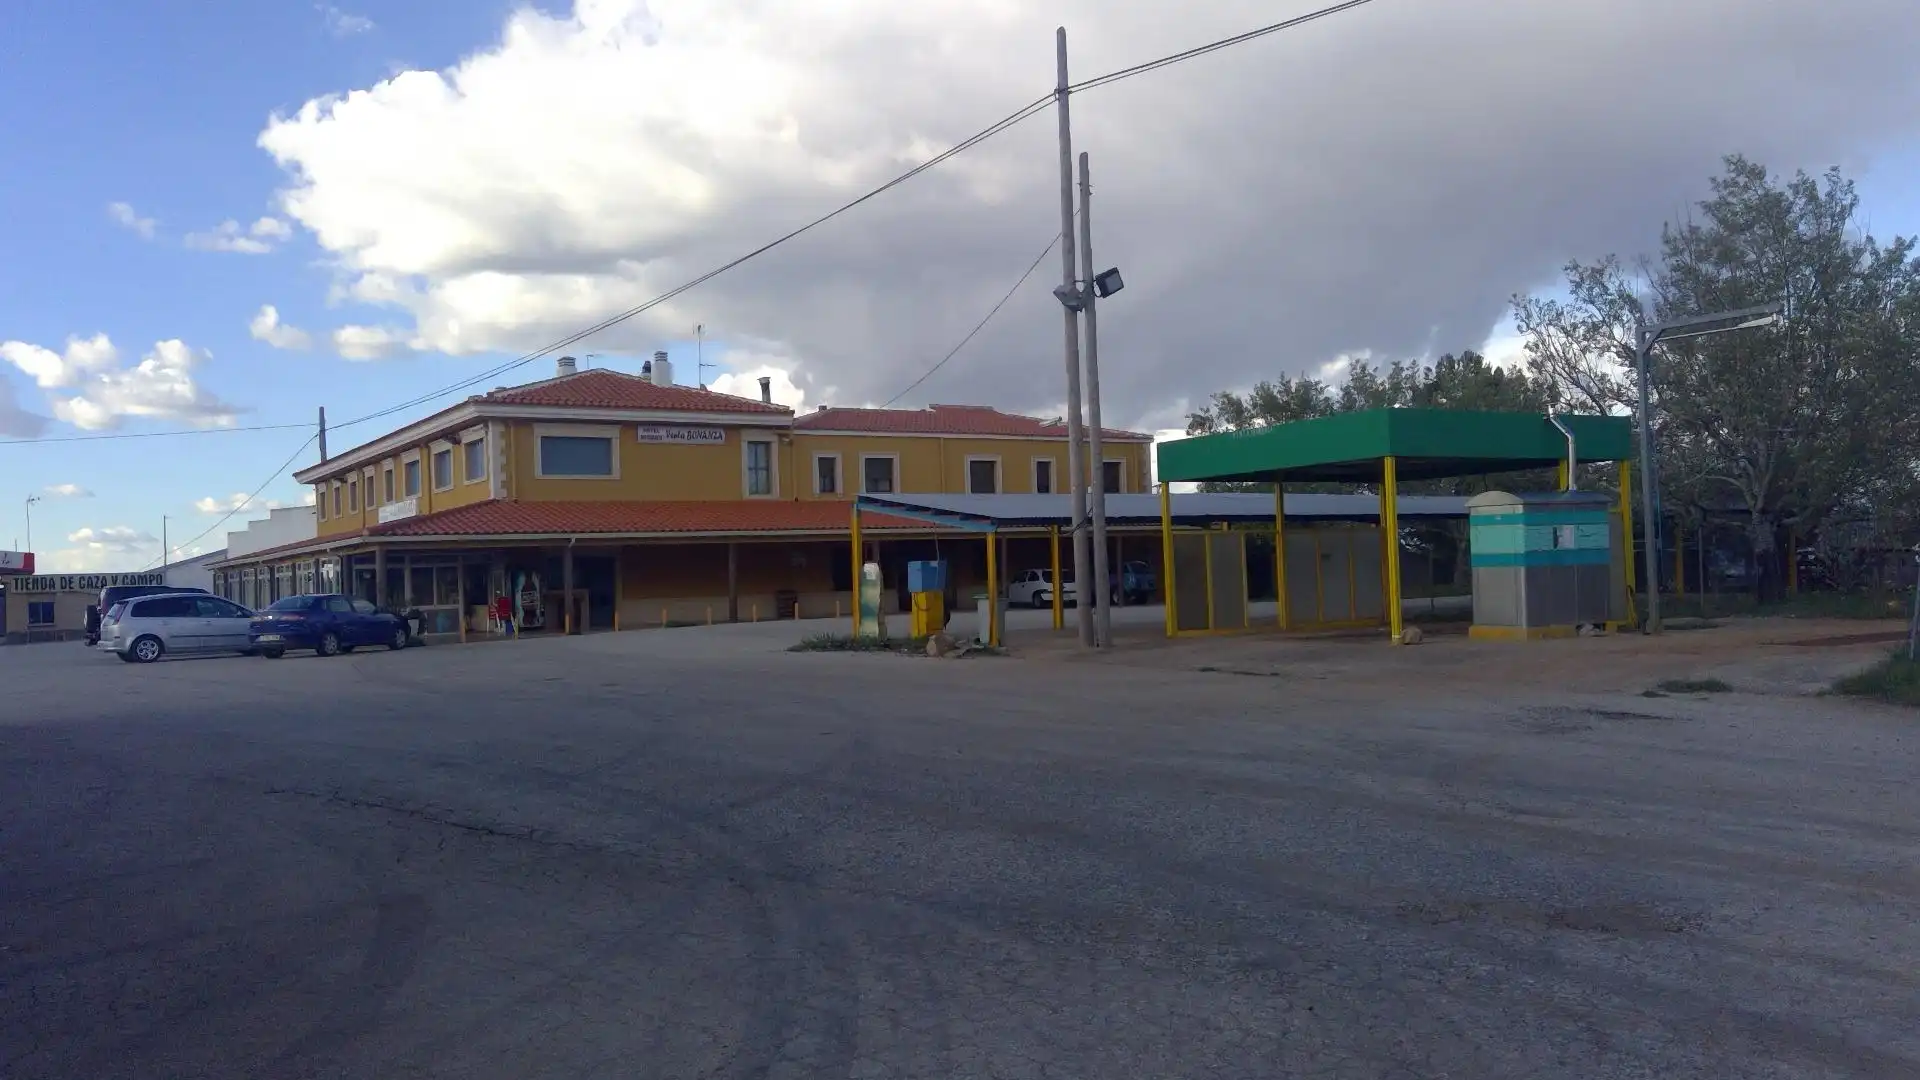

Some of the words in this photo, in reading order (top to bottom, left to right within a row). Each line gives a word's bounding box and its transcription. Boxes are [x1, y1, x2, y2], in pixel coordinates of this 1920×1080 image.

[686, 429, 723, 441] BONANZA
[13, 576, 56, 591] TIENDA
[60, 576, 75, 590] DE
[78, 575, 108, 590] CAZA
[122, 573, 163, 586] CAMPO
